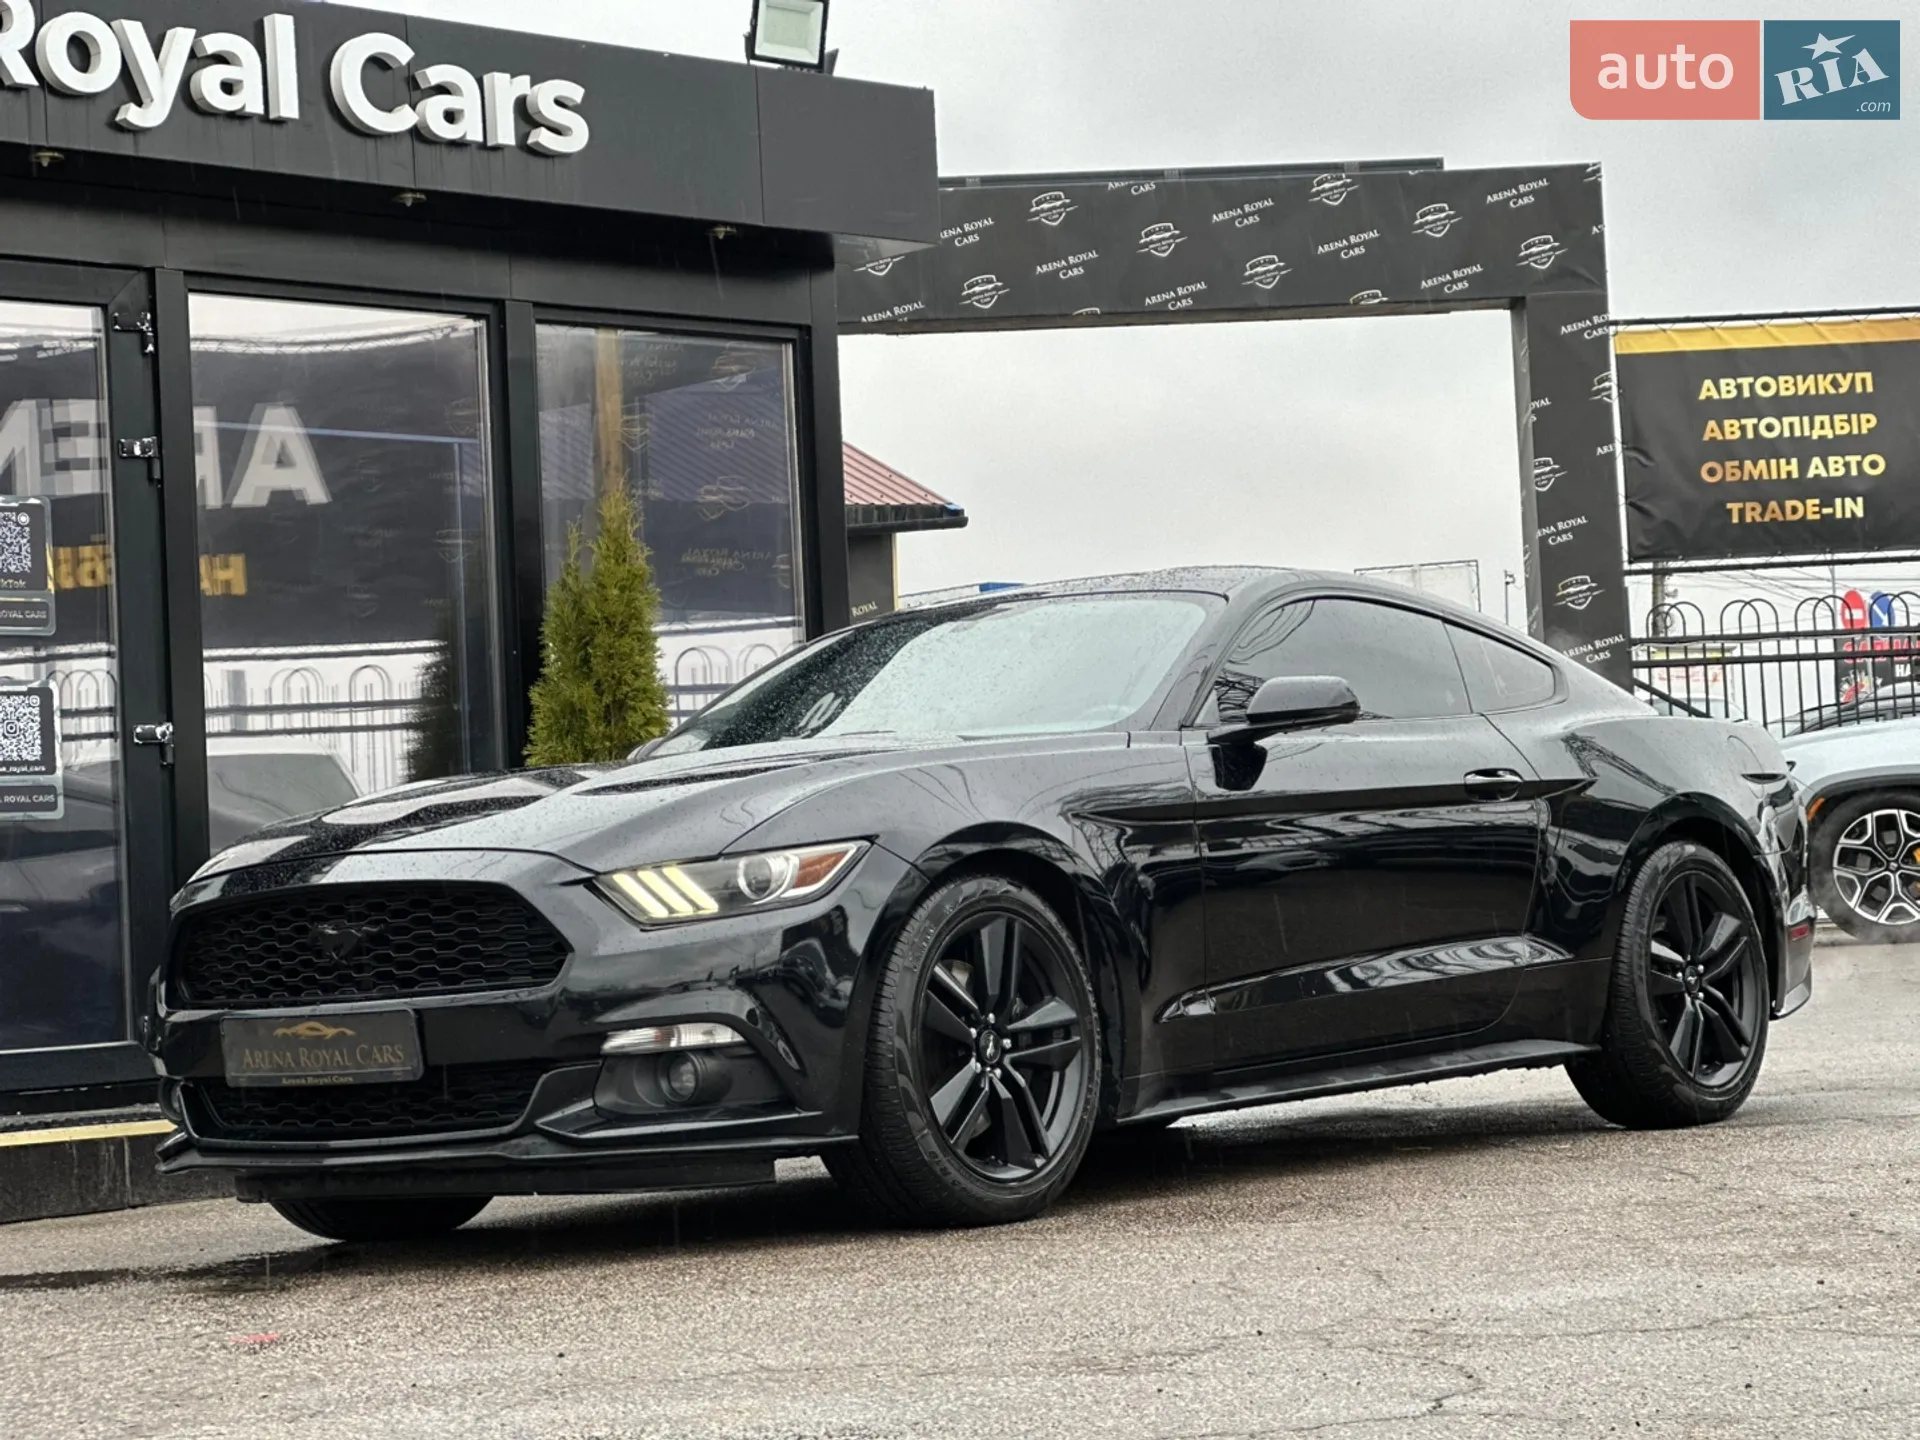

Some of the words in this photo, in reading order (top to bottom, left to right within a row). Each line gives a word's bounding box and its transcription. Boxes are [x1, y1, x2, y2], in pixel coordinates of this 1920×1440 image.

[329, 32, 590, 156] Cars
[1130, 181, 1156, 196] CARS
[1486, 187, 1518, 204] ARENA
[1518, 178, 1550, 193] ROYAL
[1509, 194, 1535, 208] CARS
[1211, 207, 1243, 223] ARENA
[1243, 197, 1275, 213] ROYAL
[963, 217, 995, 232] ROYAL
[1235, 213, 1260, 227] CARS
[954, 233, 980, 247] CARS
[1317, 239, 1349, 255] ARENA
[1349, 229, 1380, 244] ROYAL
[1340, 245, 1366, 259] CARS
[1035, 259, 1068, 275] ARENA
[1067, 249, 1099, 265] ROYAL
[1059, 266, 1085, 279] CARS
[1420, 273, 1452, 290] ARENA
[1452, 263, 1484, 279] ROYAL
[1144, 290, 1176, 306] ARENA
[1176, 281, 1208, 297] ROYAL
[1443, 280, 1470, 294] CARS
[893, 300, 926, 316] ROYAL
[1167, 297, 1193, 311] CARS
[1560, 319, 1592, 335] ARENA
[1698, 371, 1874, 400] АВТОВИКУП
[1702, 413, 1878, 441] АВТОПІДБІР
[1701, 457, 1799, 483] ОБМІН
[1807, 454, 1886, 479] АВТО
[1726, 497, 1864, 523] TRADE-IN
[1556, 515, 1588, 531] ROYAL
[1548, 531, 1573, 546] CARS
[851, 601, 879, 617] ROYAL
[1594, 633, 1627, 649] ROYAL
[1585, 650, 1611, 664] CARS
[4, 795, 31, 803] ROYAL
[32, 794, 56, 803] CARS
[243, 1048, 295, 1069] ARENA
[299, 1046, 352, 1068] ROYAL
[355, 1043, 405, 1065] CARS
[308, 1075, 332, 1085] Royal
[332, 1075, 354, 1084] Cars
